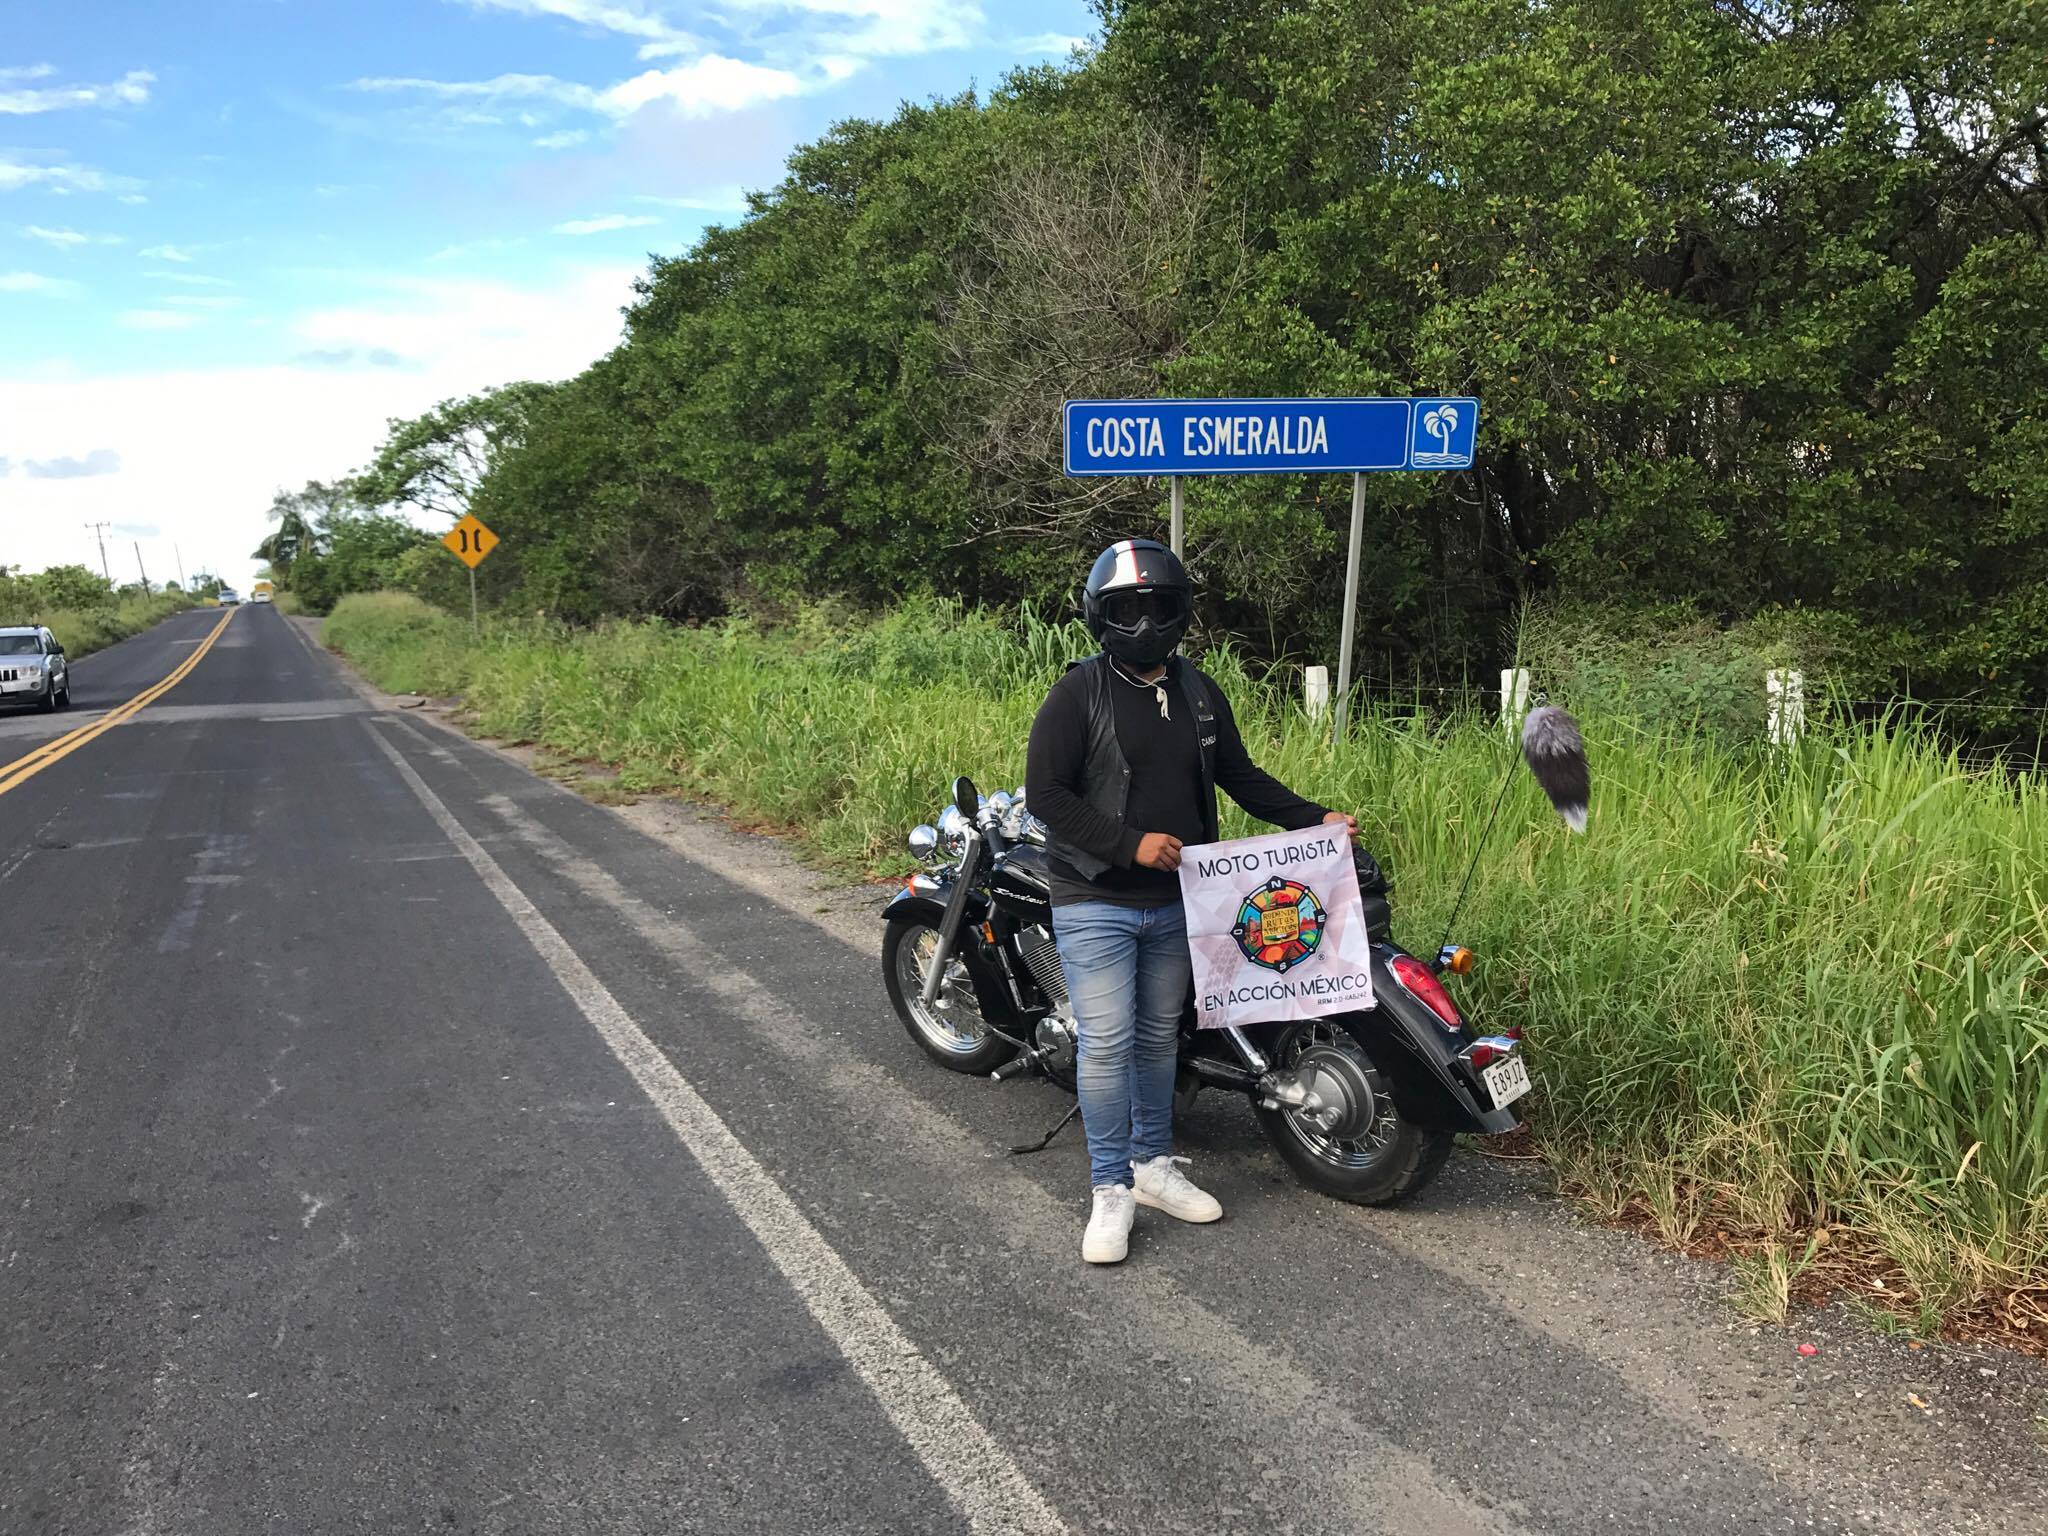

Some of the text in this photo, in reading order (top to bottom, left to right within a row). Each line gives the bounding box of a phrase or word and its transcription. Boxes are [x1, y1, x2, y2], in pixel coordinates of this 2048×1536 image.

[1086, 415, 1329, 458] COSTA ESMERALDA
[1198, 838, 1338, 878] MOTO TURISTA
[1271, 880, 1282, 889] N
[1317, 915, 1326, 923] E
[1279, 962, 1287, 970] S
[1204, 973, 1368, 1012] EN ACCIÓN MÉXICO
